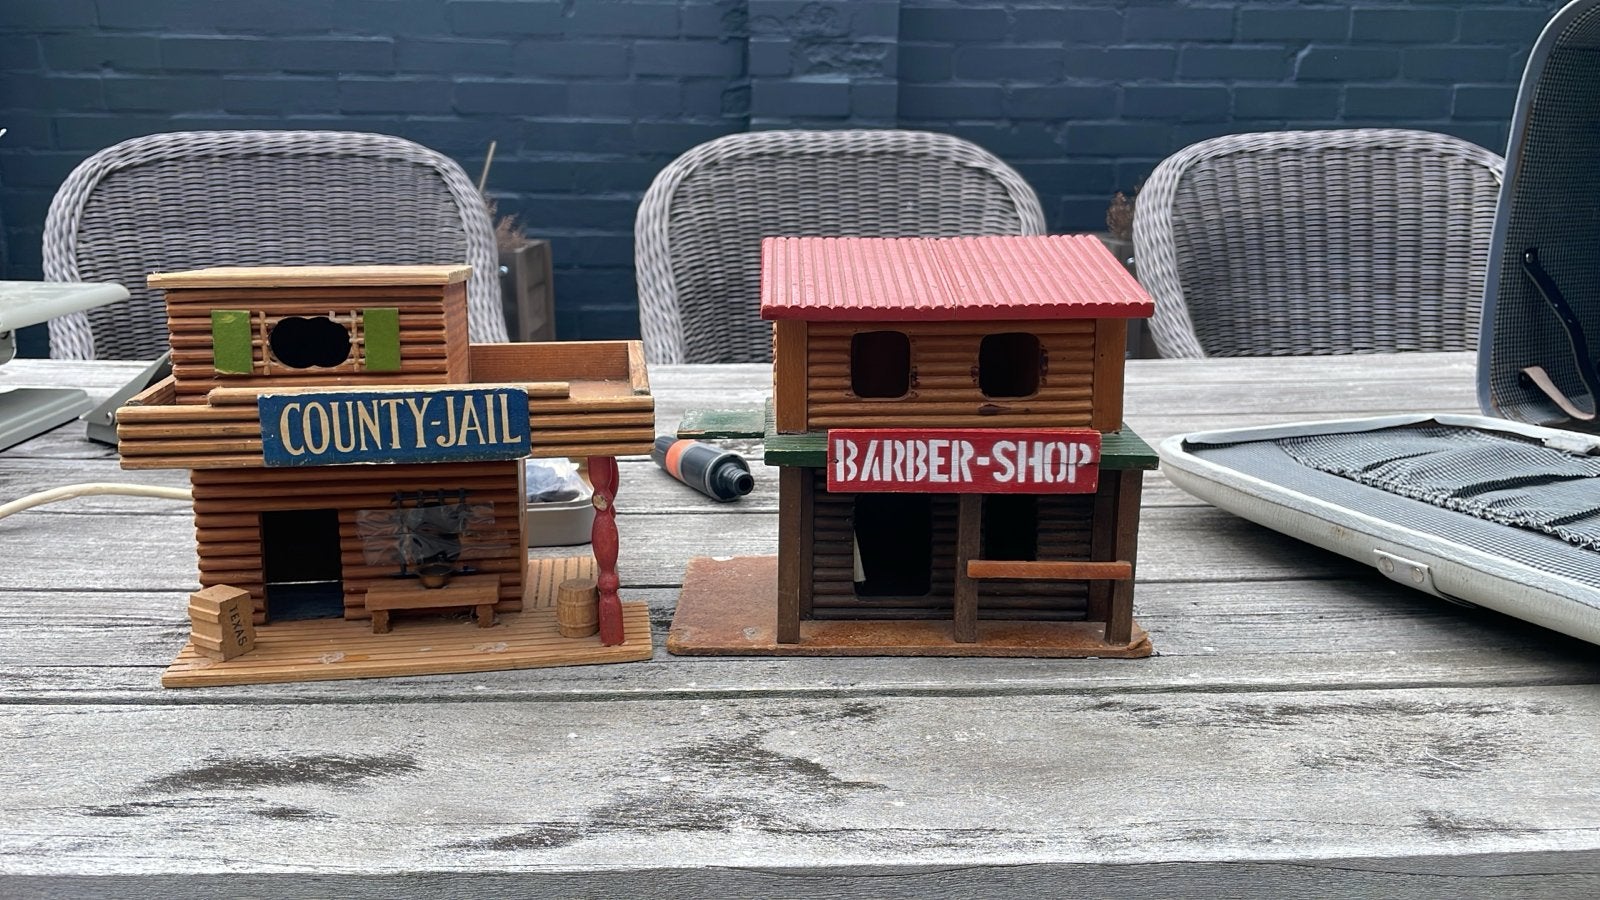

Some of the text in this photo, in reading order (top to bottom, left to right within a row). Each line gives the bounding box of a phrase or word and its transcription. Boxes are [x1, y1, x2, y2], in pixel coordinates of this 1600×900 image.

[279, 393, 522, 456] COUNTY-JAIL
[835, 439, 1092, 483] BARBER-SHOP
[229, 604, 248, 647] TEXAS
